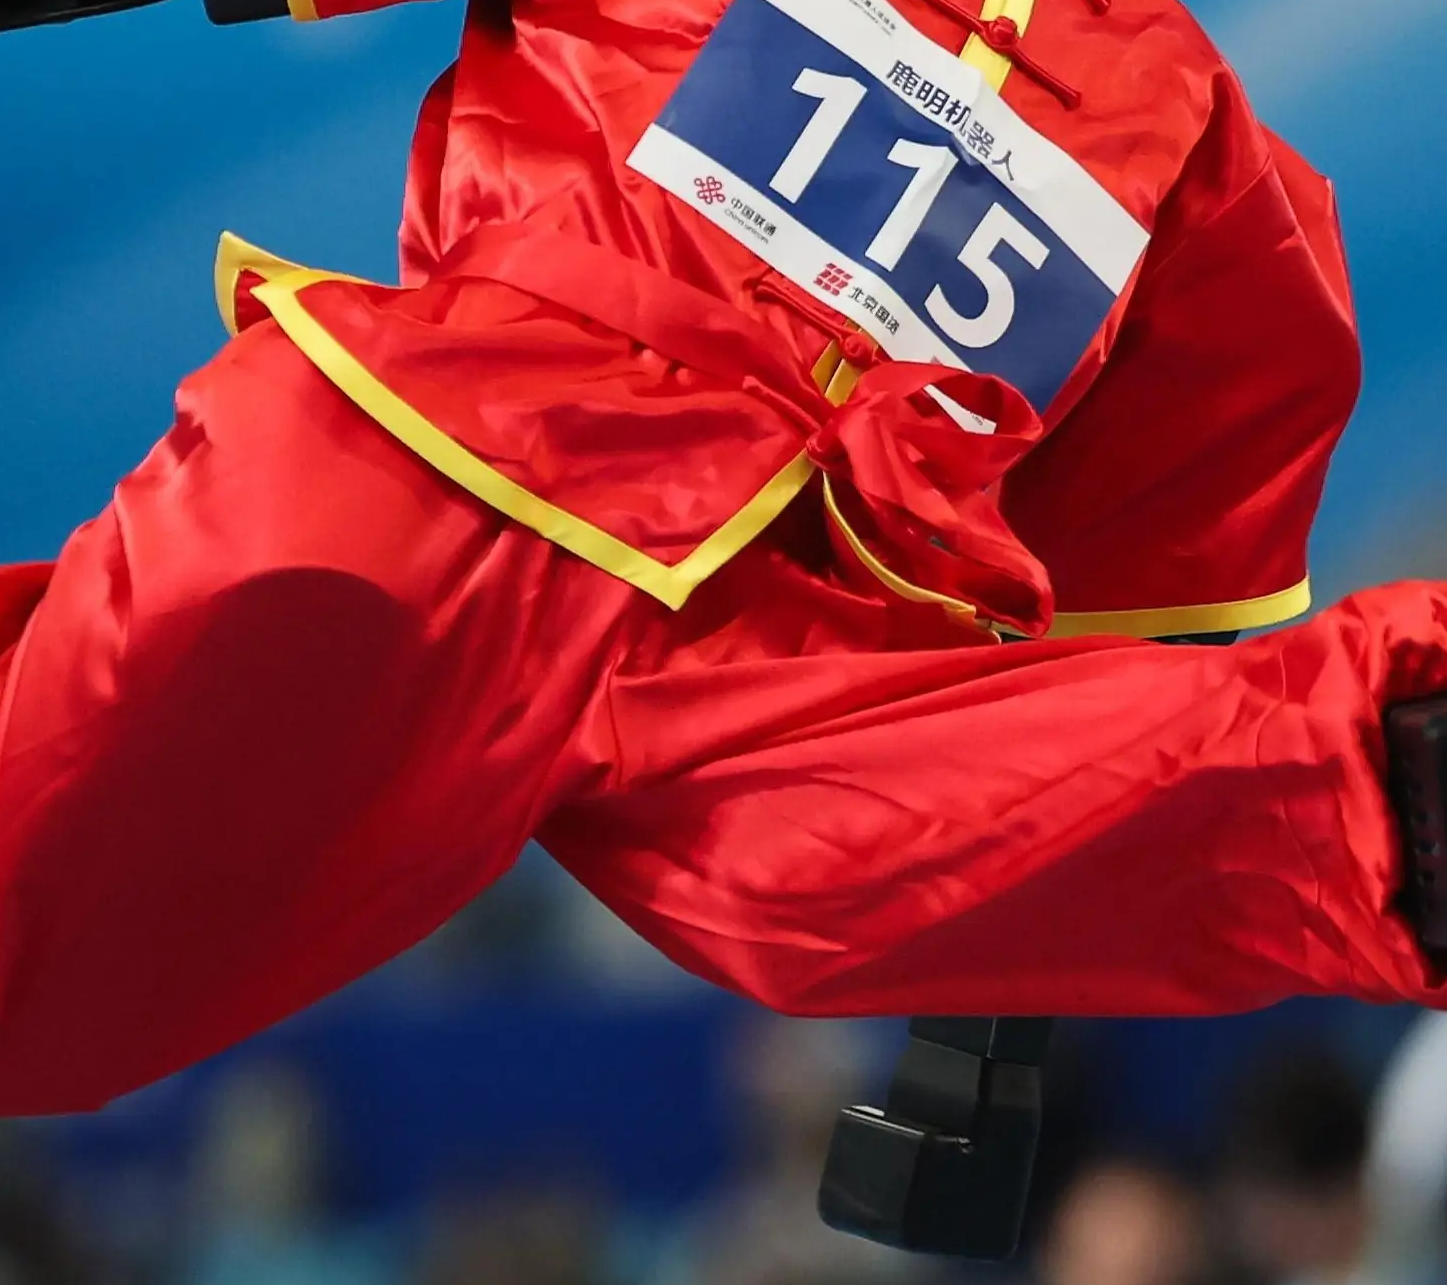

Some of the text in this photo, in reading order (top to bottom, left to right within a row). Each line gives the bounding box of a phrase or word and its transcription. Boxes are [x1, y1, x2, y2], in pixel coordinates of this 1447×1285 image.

[886, 59, 1014, 181] 鹿明机器人
[730, 197, 777, 236] 中国联通
[768, 67, 1051, 349] 115
[848, 286, 900, 335] 北京国资
